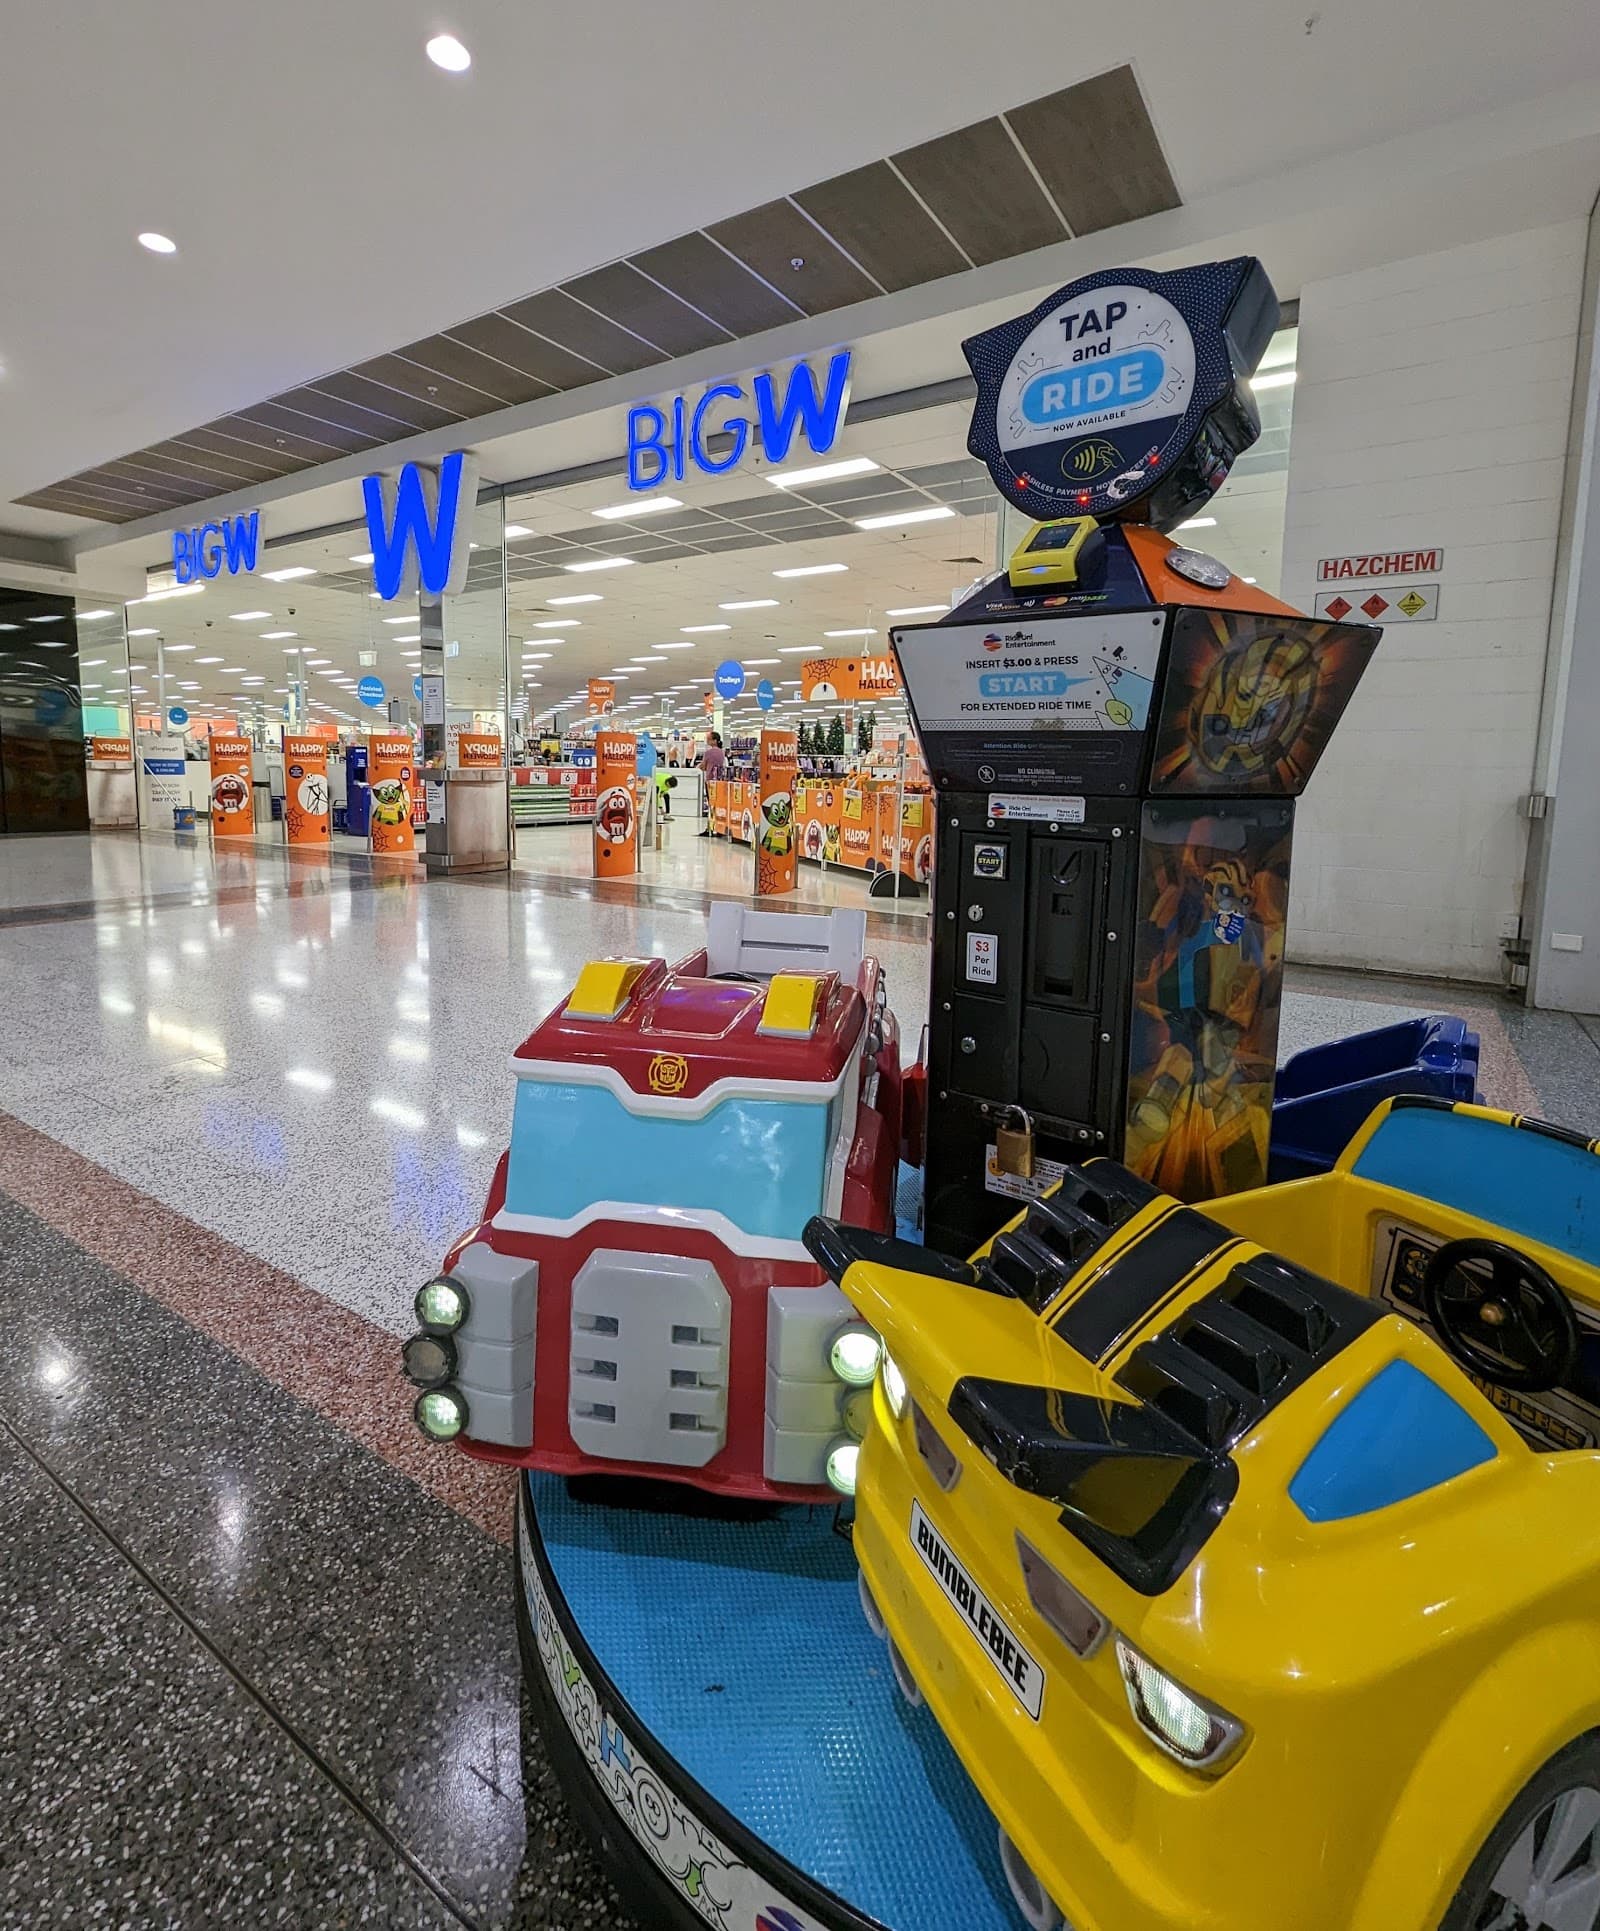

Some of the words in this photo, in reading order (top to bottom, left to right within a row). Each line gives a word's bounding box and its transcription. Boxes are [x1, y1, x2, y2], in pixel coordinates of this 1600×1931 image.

[1059, 301, 1128, 342] TAP
[1072, 338, 1111, 363] and
[1041, 361, 1144, 415] RIDE
[1053, 421, 1074, 433] NOW
[1076, 410, 1126, 428] AVAILABLE
[1022, 471, 1054, 493] CASHLESS
[1056, 486, 1093, 496] PAYMENT
[362, 451, 466, 601] W
[1323, 551, 1437, 579] HAZCHEM
[1005, 639, 1056, 649] Entertainment
[966, 660, 1001, 669] INSERT
[1003, 658, 1032, 669] $3.00
[1035, 658, 1041, 666] &
[1044, 656, 1079, 666] PRESS
[718, 676, 741, 685] Trolleys
[988, 675, 1057, 694] START
[960, 703, 981, 712] FOR
[982, 702, 1036, 712] EXTENDED
[1039, 701, 1063, 711] RIDE
[1065, 700, 1092, 710] TIME
[215, 743, 249, 753] HAPPY
[290, 743, 324, 753] HAPPY
[376, 743, 411, 753] HAPPY
[603, 741, 636, 755] HAPPY
[768, 742, 796, 756] HAPP
[845, 798, 851, 812] 7
[902, 804, 909, 820] 2
[844, 828, 870, 844] HAPPY
[882, 834, 913, 852] HAPY
[977, 857, 1000, 865] START
[975, 940, 989, 953] $3
[975, 955, 989, 964] Per
[972, 965, 991, 977] Ride
[918, 1516, 1029, 1694] BUMBLEBEE
